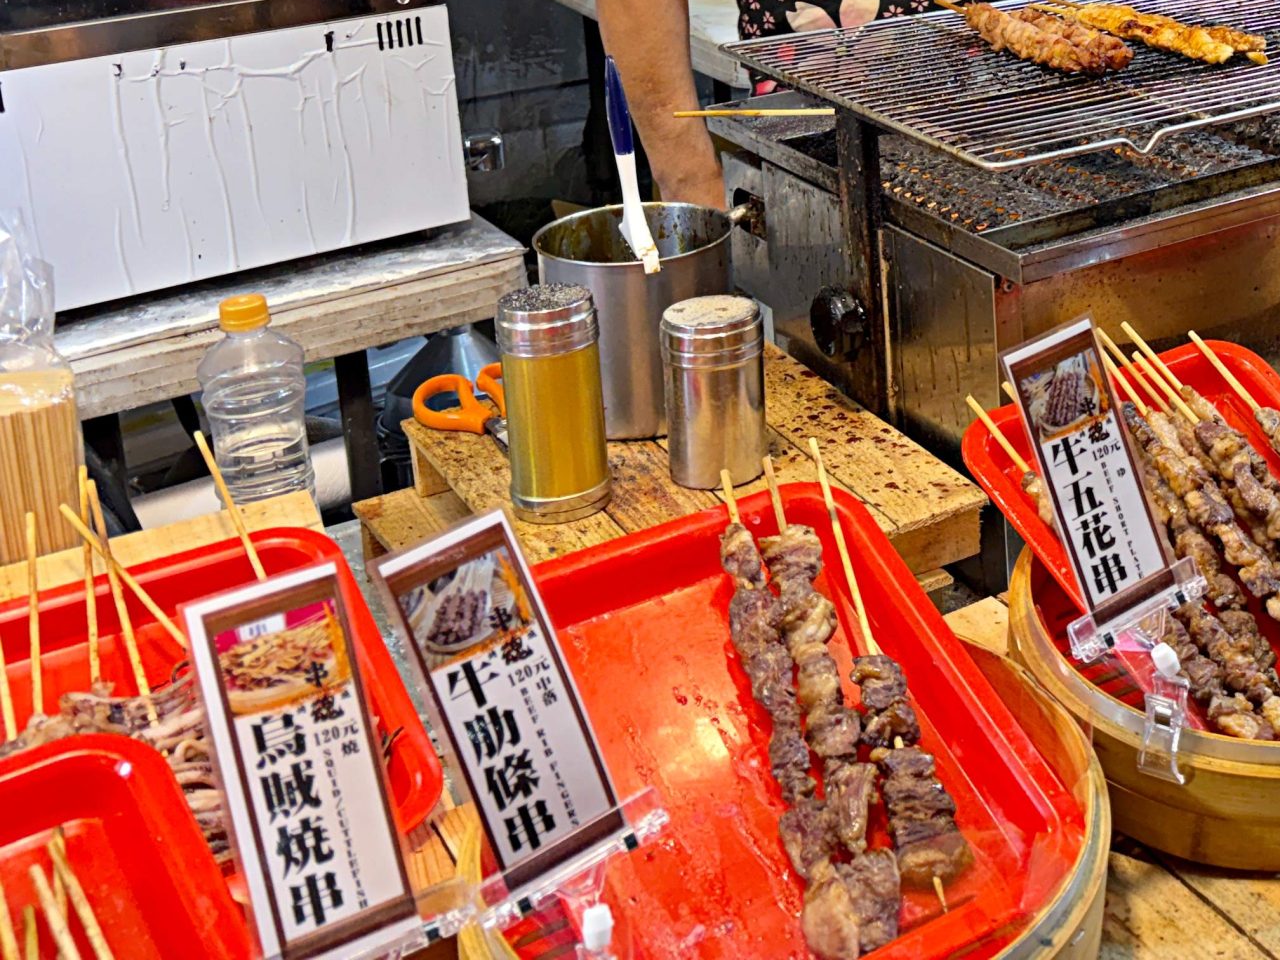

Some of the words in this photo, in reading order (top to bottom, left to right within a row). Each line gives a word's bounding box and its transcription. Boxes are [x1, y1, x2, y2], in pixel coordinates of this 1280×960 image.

[1052, 436, 1129, 595] 牛五花串
[507, 655, 551, 689] 120元
[313, 719, 360, 747] 120元
[446, 661, 558, 853] 牛肋條串
